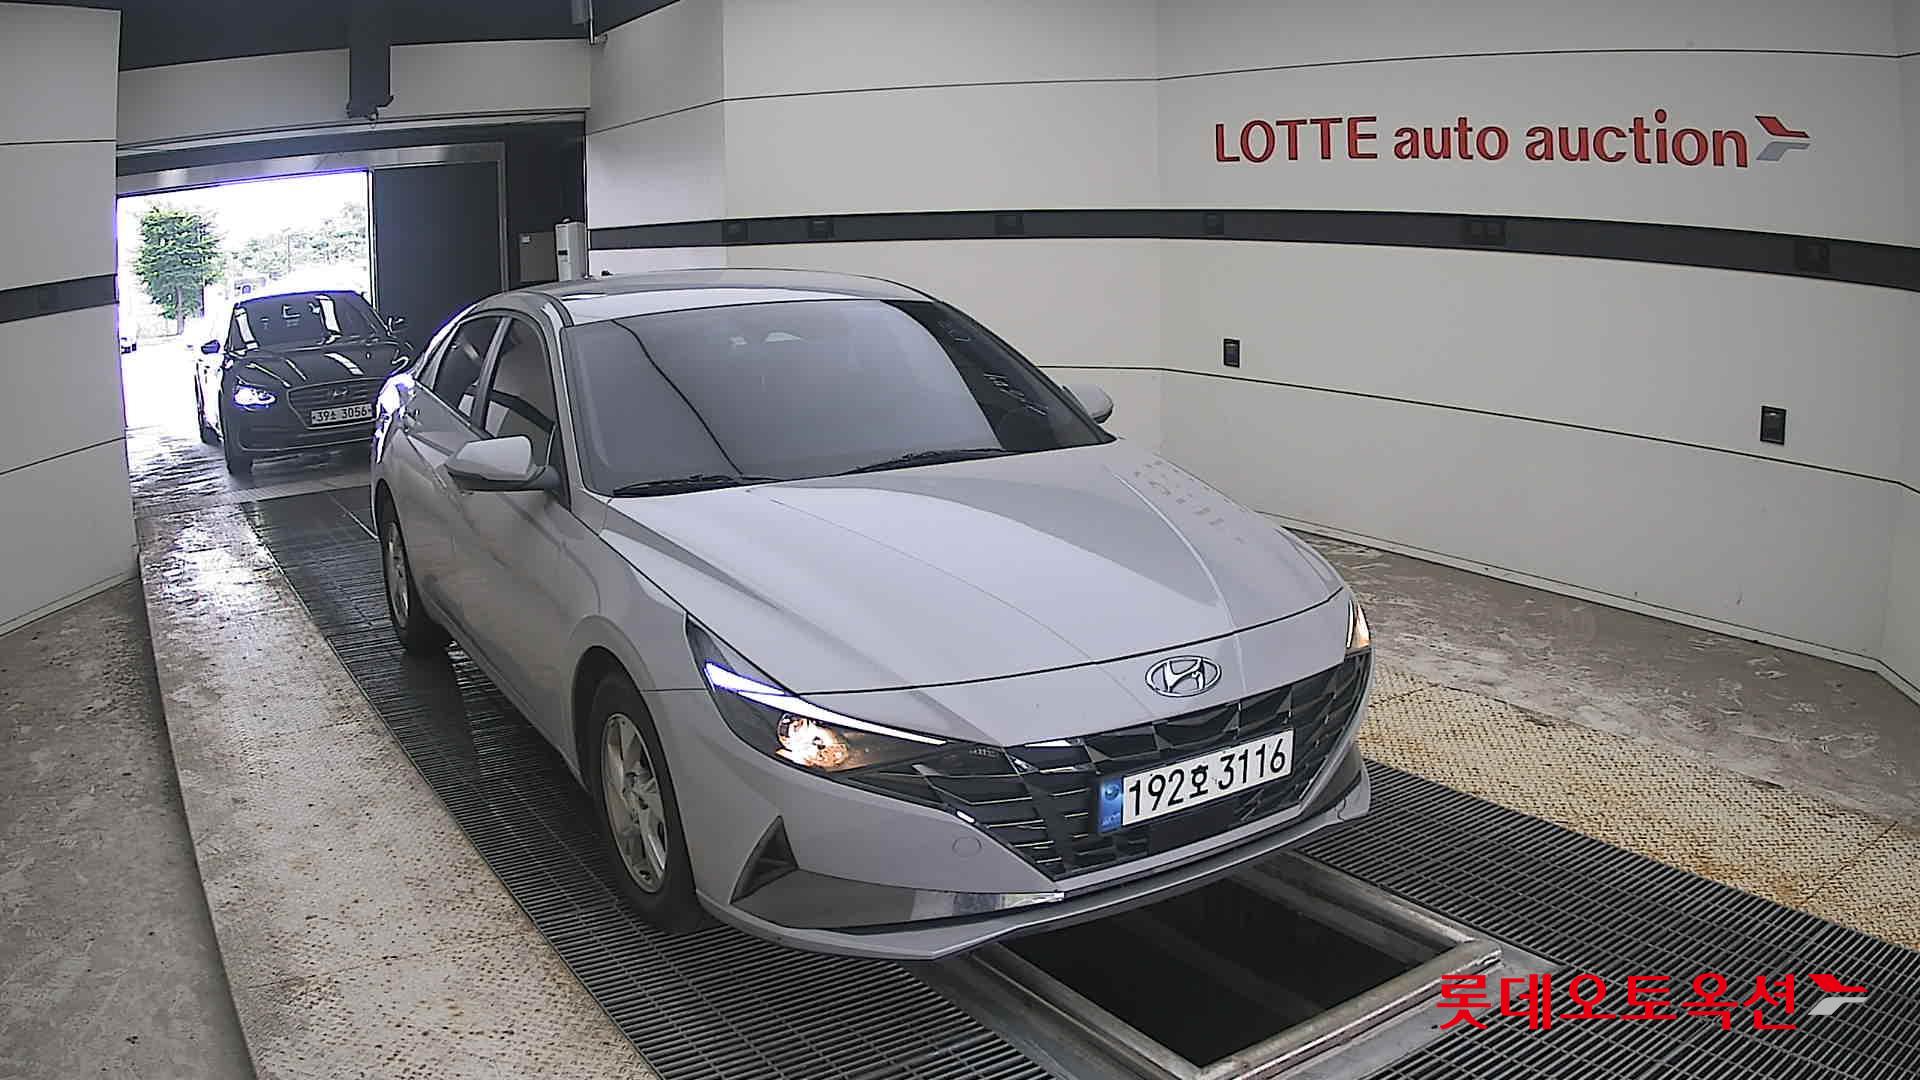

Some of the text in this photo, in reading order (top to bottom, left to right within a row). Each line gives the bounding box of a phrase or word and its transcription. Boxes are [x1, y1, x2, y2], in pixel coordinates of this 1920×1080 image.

[1215, 109, 1748, 168] LOTTE auto auction
[341, 406, 368, 419] 3056
[1129, 738, 1286, 817] 192호 3116
